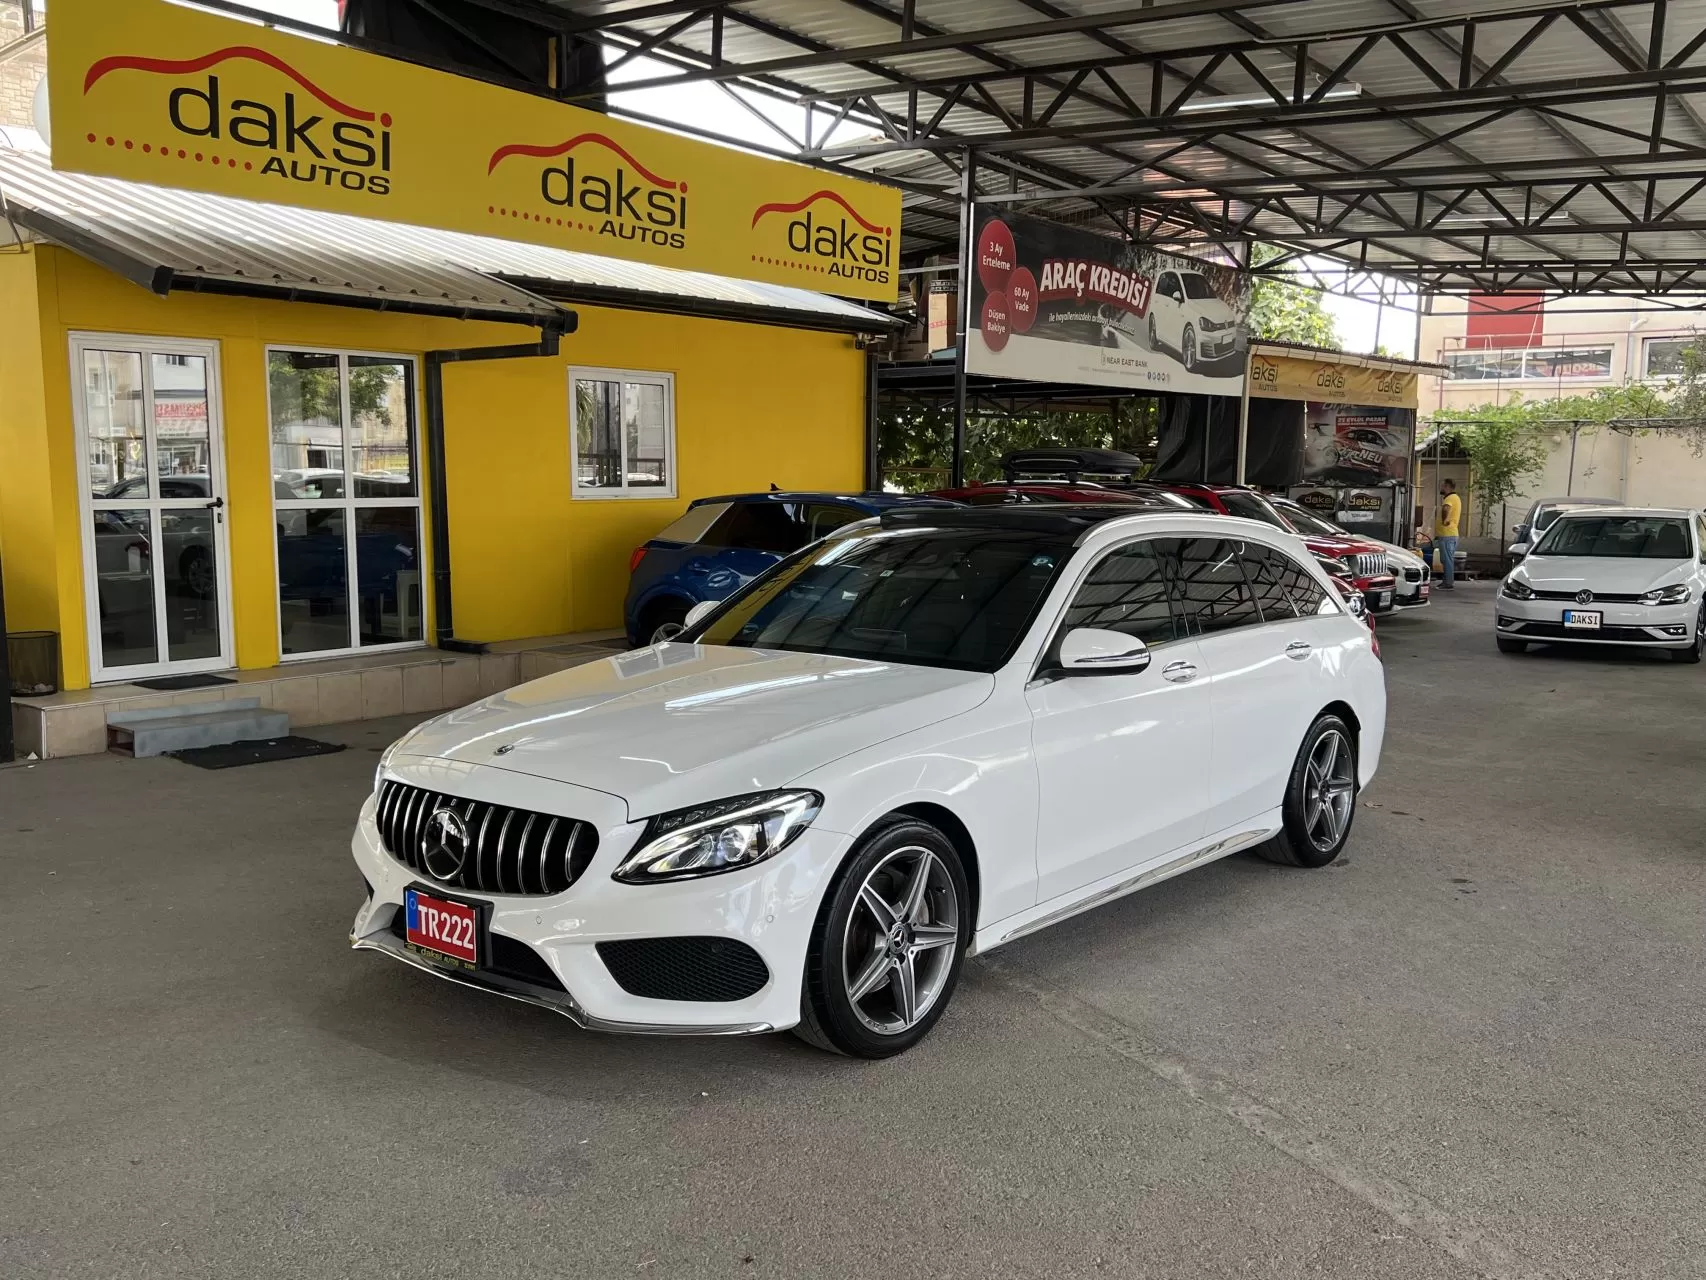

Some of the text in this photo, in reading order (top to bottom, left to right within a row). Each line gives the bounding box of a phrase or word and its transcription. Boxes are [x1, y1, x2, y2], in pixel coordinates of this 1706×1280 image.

[169, 75, 392, 171] daksi
[260, 156, 390, 195] AUTOS
[541, 157, 688, 230] daksi
[599, 220, 685, 249] AUTOS
[788, 211, 892, 268] daksi
[989, 242, 1004, 256] 3 Ay
[983, 255, 1010, 270] Erteleme
[828, 262, 890, 284] AUTOS
[1014, 286, 1030, 301] 60 Ay
[1040, 262, 1149, 310] ARAÇ KREDİSİ
[989, 309, 1005, 321] Düşen
[1015, 301, 1030, 313] Vade
[988, 322, 1005, 334] Bakiye
[1107, 356, 1120, 365] NEAR
[1121, 358, 1134, 367] EAST
[1317, 370, 1346, 390] daksi
[1304, 496, 1334, 504] daksi
[1571, 614, 1597, 625] DAKSI
[418, 905, 473, 950] TR222
